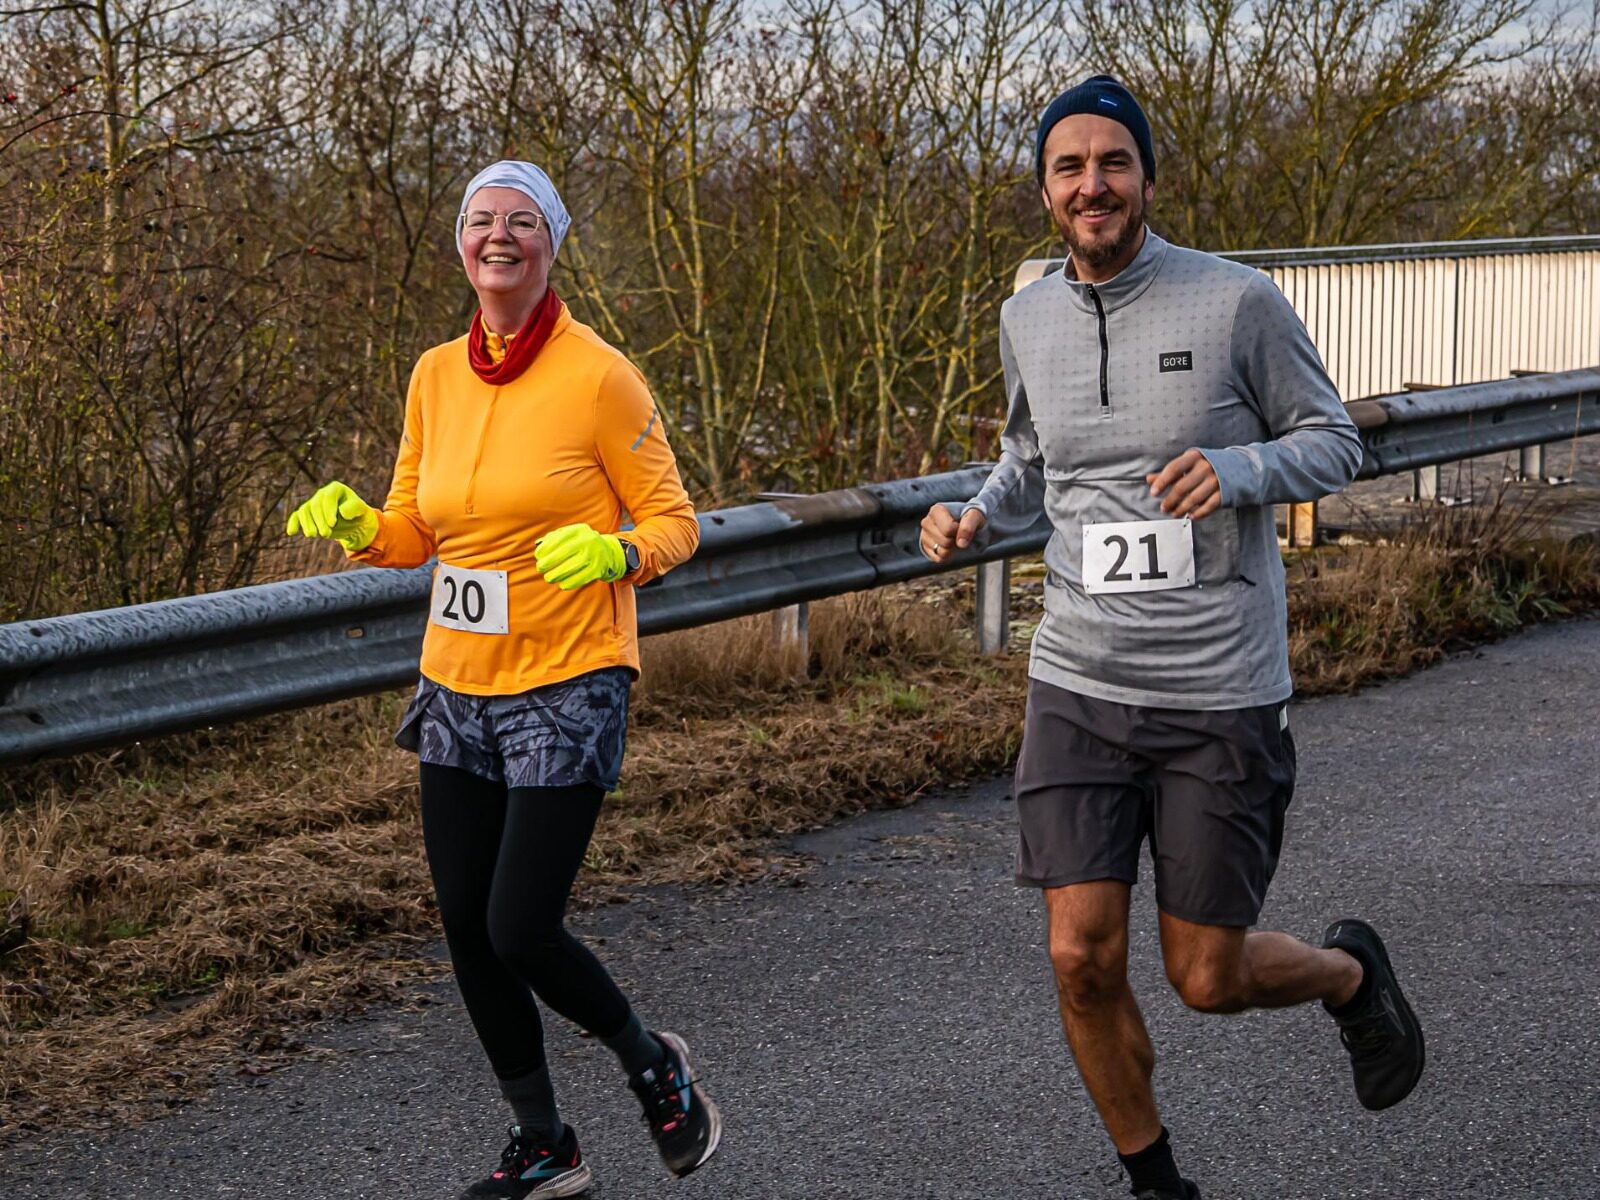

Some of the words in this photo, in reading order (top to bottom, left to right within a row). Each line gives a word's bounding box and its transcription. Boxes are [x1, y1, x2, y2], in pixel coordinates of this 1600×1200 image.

[1163, 356, 1188, 367] GORE
[1103, 533, 1168, 582] 21
[442, 575, 486, 624] 20
